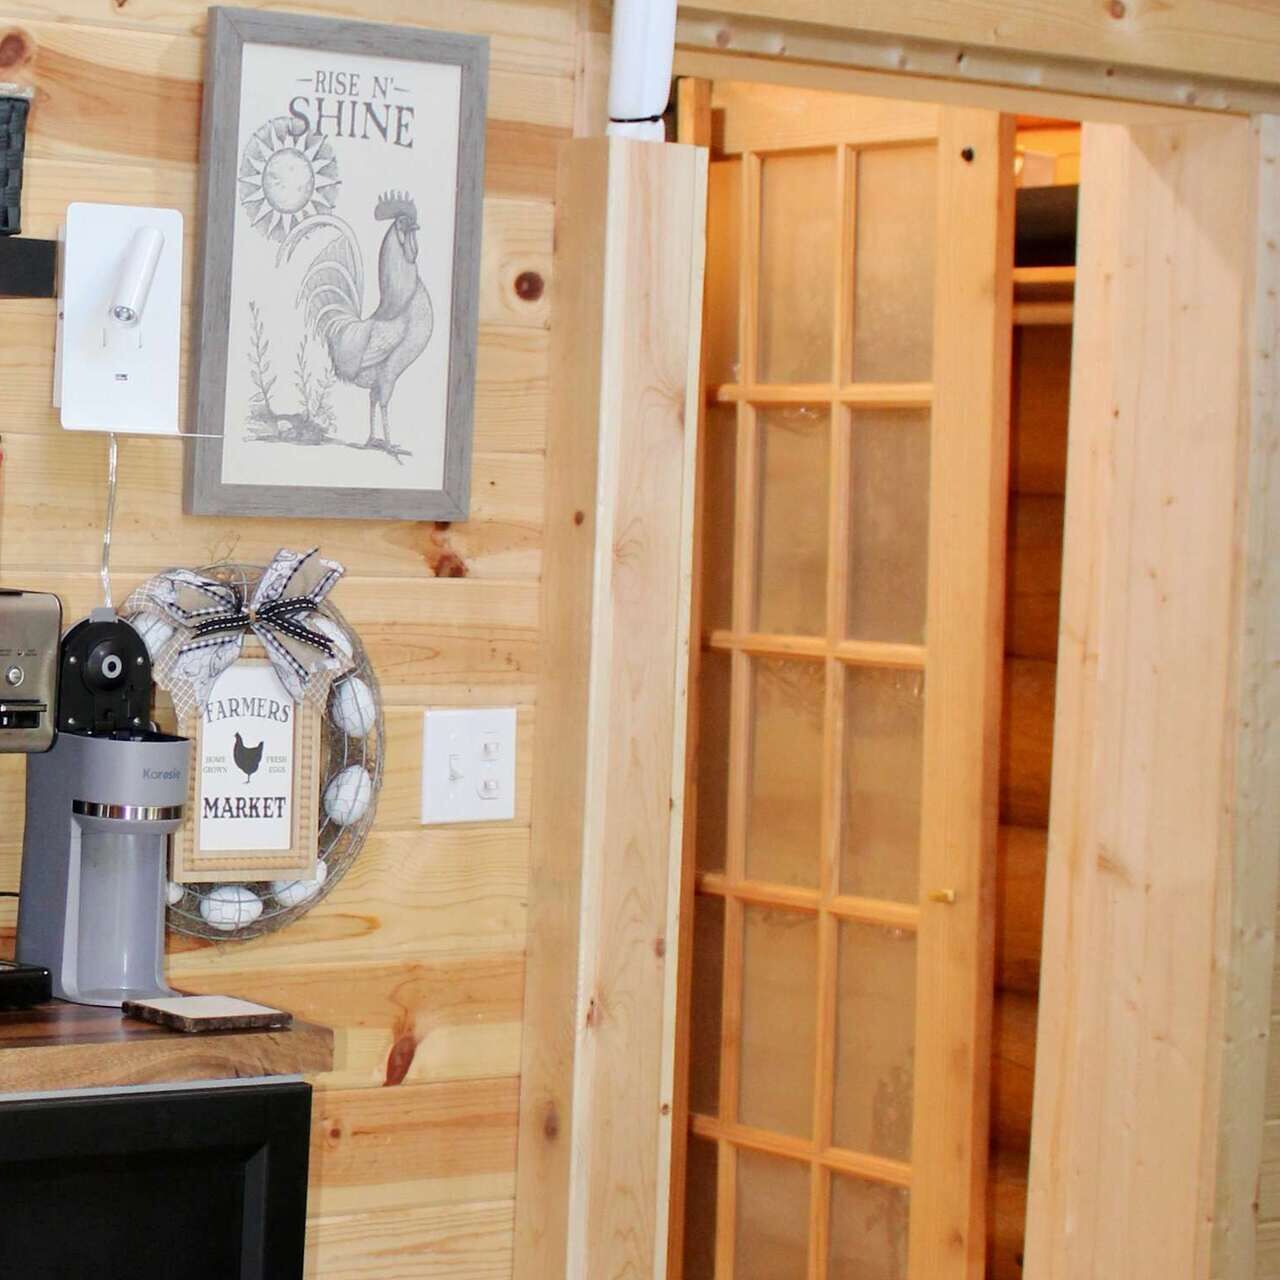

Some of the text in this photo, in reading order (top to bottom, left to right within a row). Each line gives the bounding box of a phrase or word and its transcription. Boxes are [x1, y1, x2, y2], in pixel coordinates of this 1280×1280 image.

[314, 70, 361, 97] RISE
[287, 95, 415, 149] SHINE
[205, 697, 291, 723] FARMERS
[203, 797, 287, 819] MARKET
